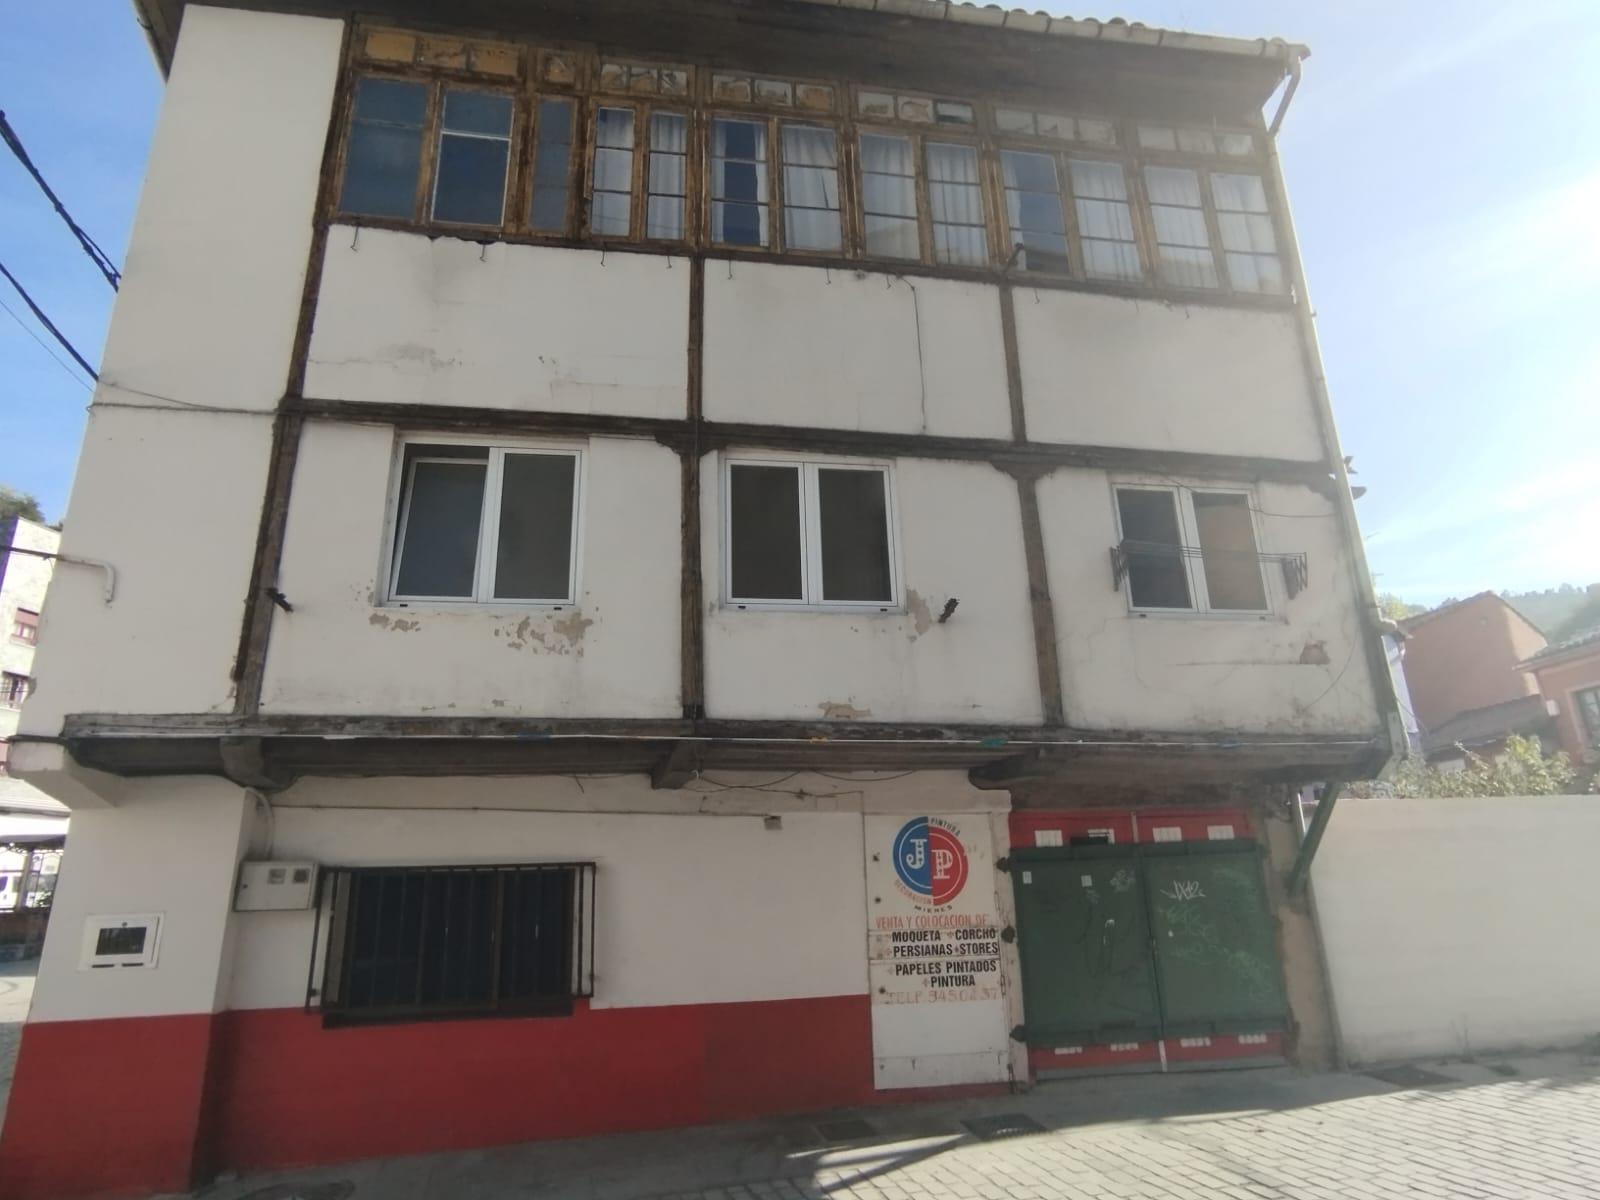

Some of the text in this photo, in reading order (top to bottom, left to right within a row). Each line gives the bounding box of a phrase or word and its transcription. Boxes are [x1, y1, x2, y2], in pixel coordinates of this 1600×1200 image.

[876, 913, 987, 929] VENTA Y COLOCACION DE
[891, 928, 996, 942] MOQUETA CORCHO
[893, 941, 999, 957] PERSIANAS STORES
[895, 960, 997, 976] PAPELES PINTADOS
[930, 975, 976, 988] PINTURA
